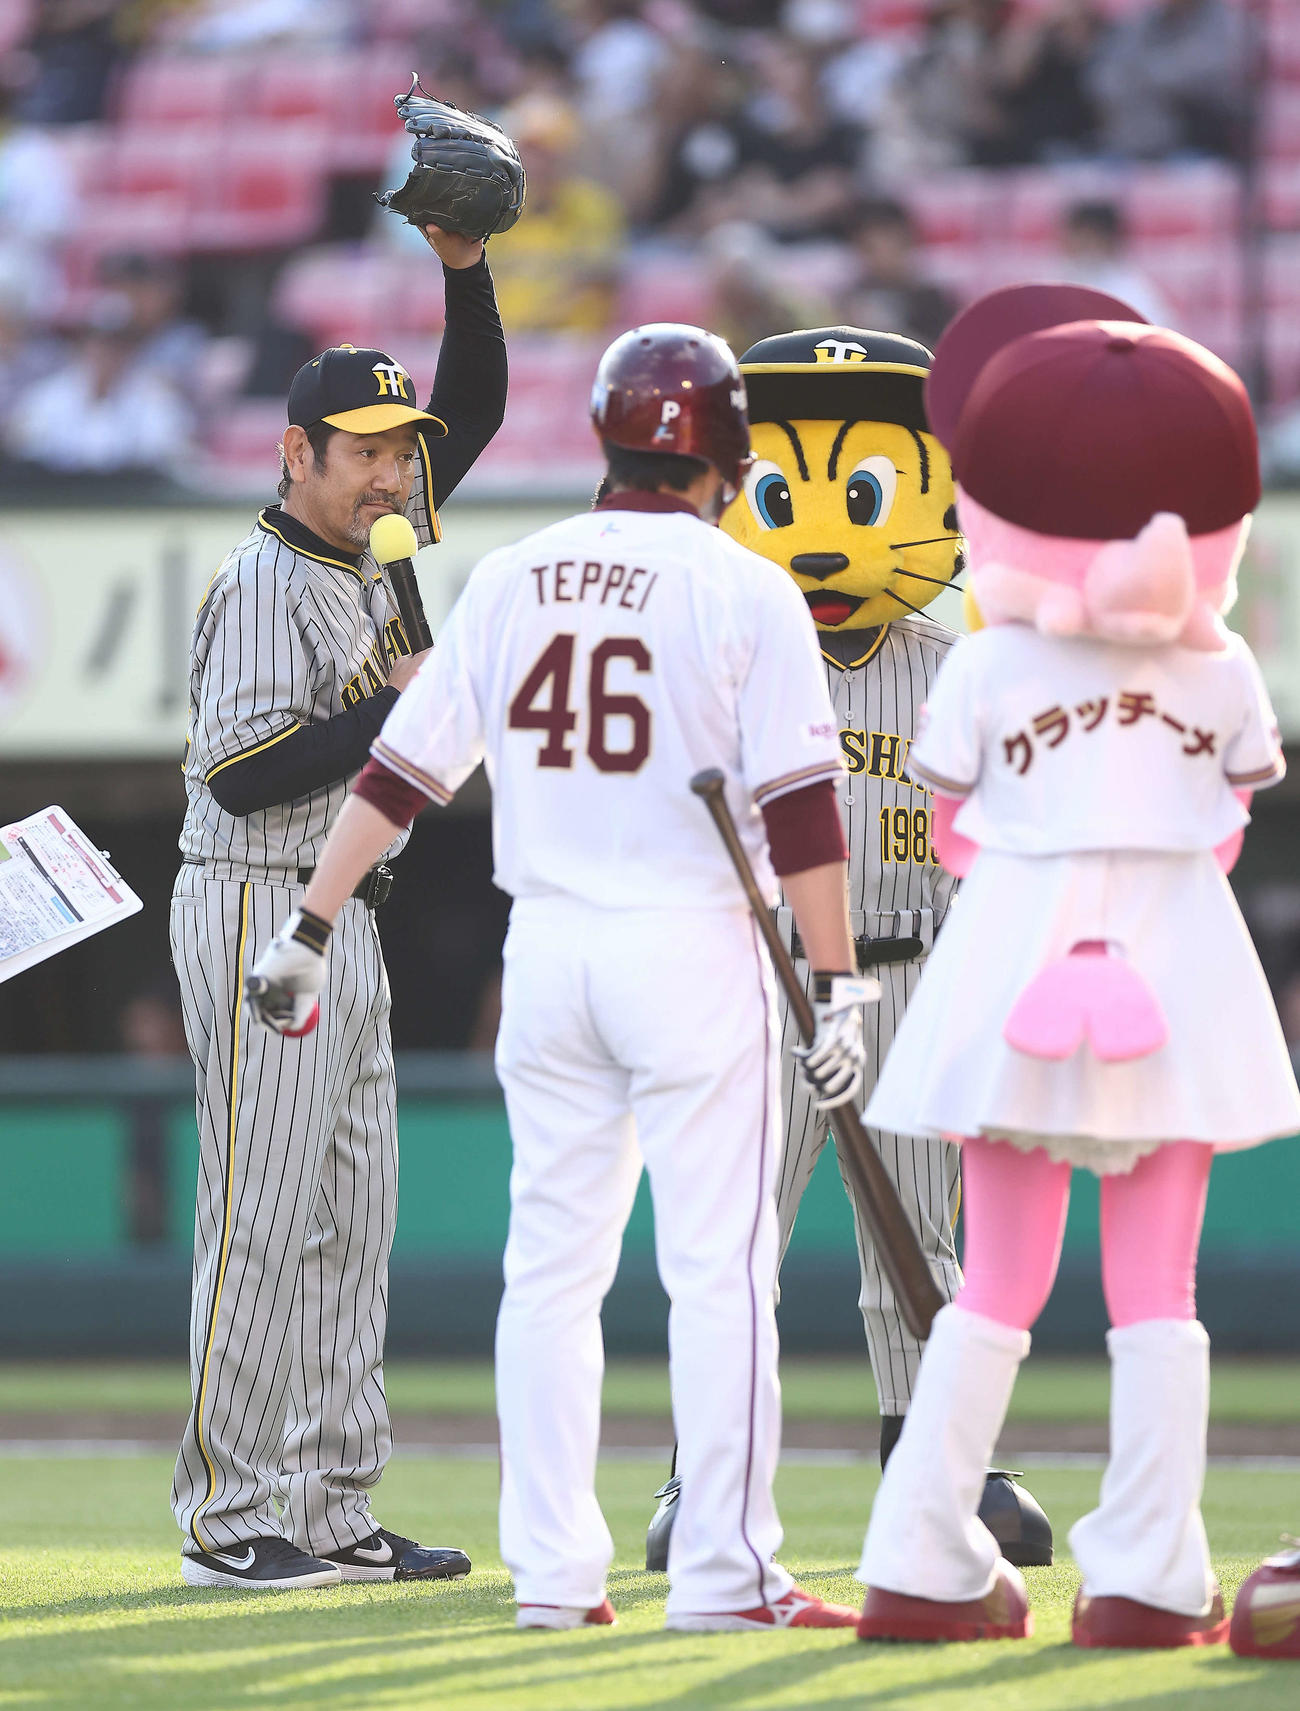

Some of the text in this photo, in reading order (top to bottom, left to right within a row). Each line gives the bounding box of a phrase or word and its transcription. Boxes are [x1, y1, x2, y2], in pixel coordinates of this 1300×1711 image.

[661, 400, 681, 425] P
[531, 561, 659, 613] TEPPEI
[507, 631, 653, 776] 46
[1003, 690, 1216, 776] クラッチーメ
